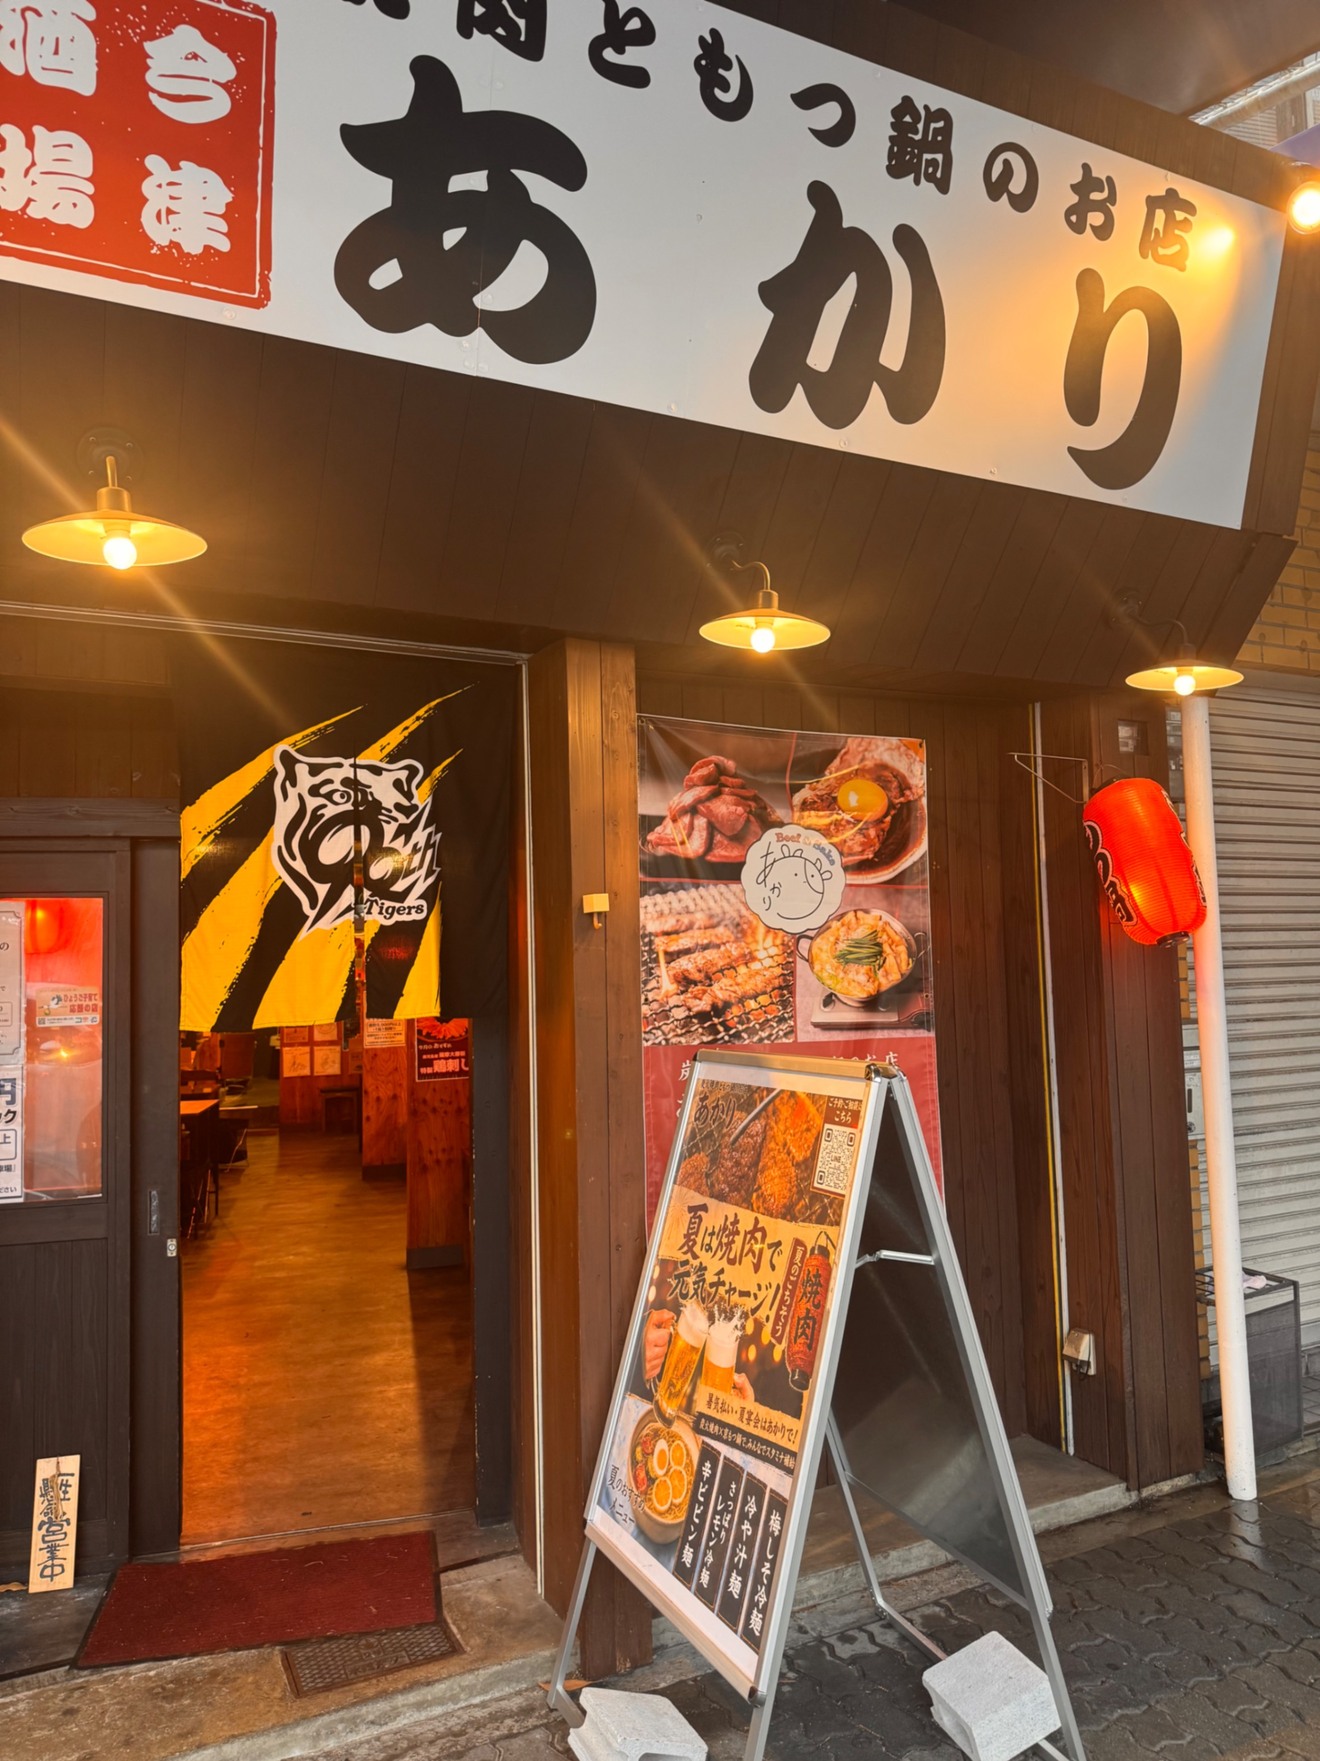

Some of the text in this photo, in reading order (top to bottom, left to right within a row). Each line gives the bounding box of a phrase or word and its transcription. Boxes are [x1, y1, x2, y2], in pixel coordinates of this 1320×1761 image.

[0, 0, 97, 229] 酒場
[142, 24, 237, 255] 今津
[343, 0, 1196, 271] 肉ともつ鍋のお店
[334, 55, 1183, 490] あかり
[774, 832, 802, 843] Beef
[364, 898, 424, 918] Tigers
[693, 1091, 737, 1129] あかり
[834, 1110, 852, 1124] こちら
[678, 1202, 783, 1274] 夏は焼肉で
[668, 1260, 782, 1324] 元気チャージ!
[774, 1245, 804, 1337] 夏のごちそう
[793, 1268, 822, 1351] 焼肉
[608, 1464, 645, 1513] 夏のおすすめ
[609, 1498, 635, 1524] メニュー
[37, 1511, 71, 1583] 営業中
[699, 1495, 726, 1588] レモン冷麺
[727, 1494, 758, 1600] 冷や汁麺
[748, 1509, 782, 1637] 梅しそ冷麺
